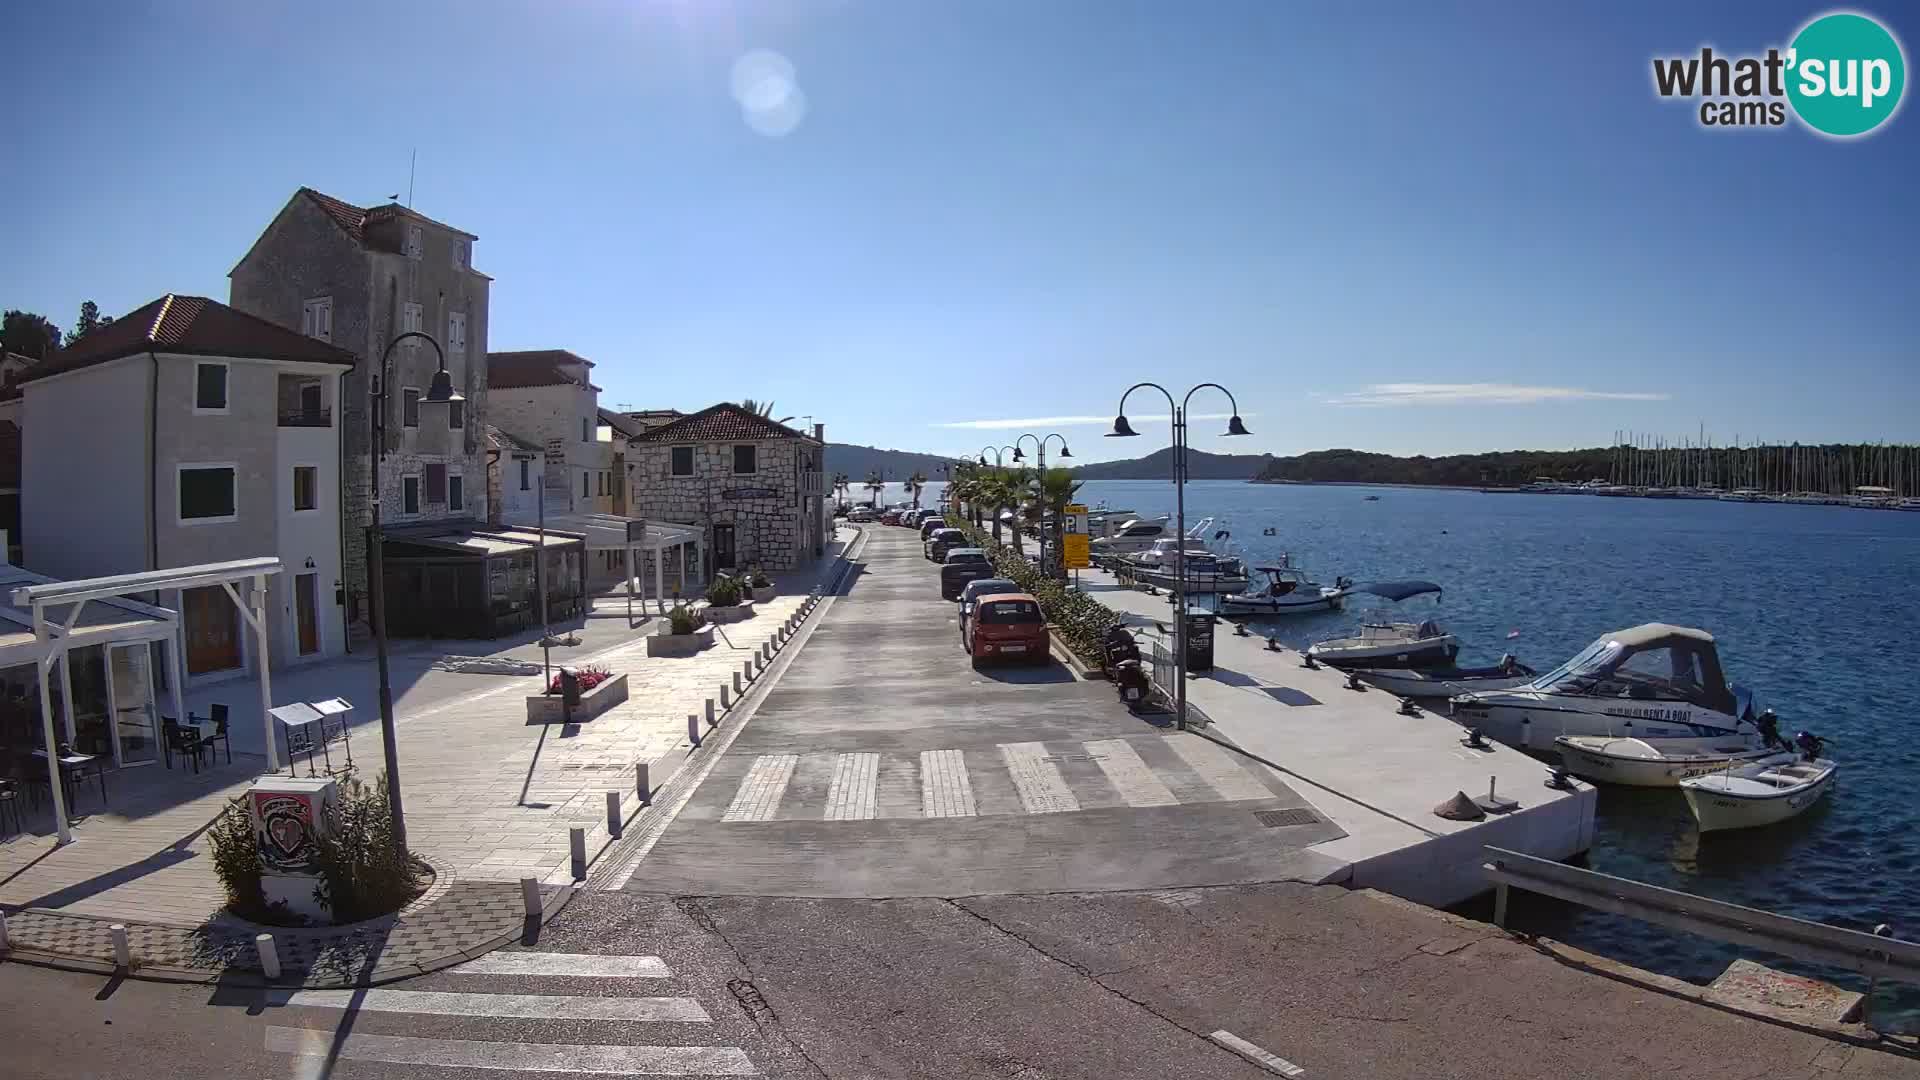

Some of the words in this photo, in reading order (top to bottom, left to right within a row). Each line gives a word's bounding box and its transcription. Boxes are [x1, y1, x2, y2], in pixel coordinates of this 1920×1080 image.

[1643, 708, 1664, 720] RENT
[1665, 709, 1671, 720] A
[1673, 710, 1692, 724] BOAT
